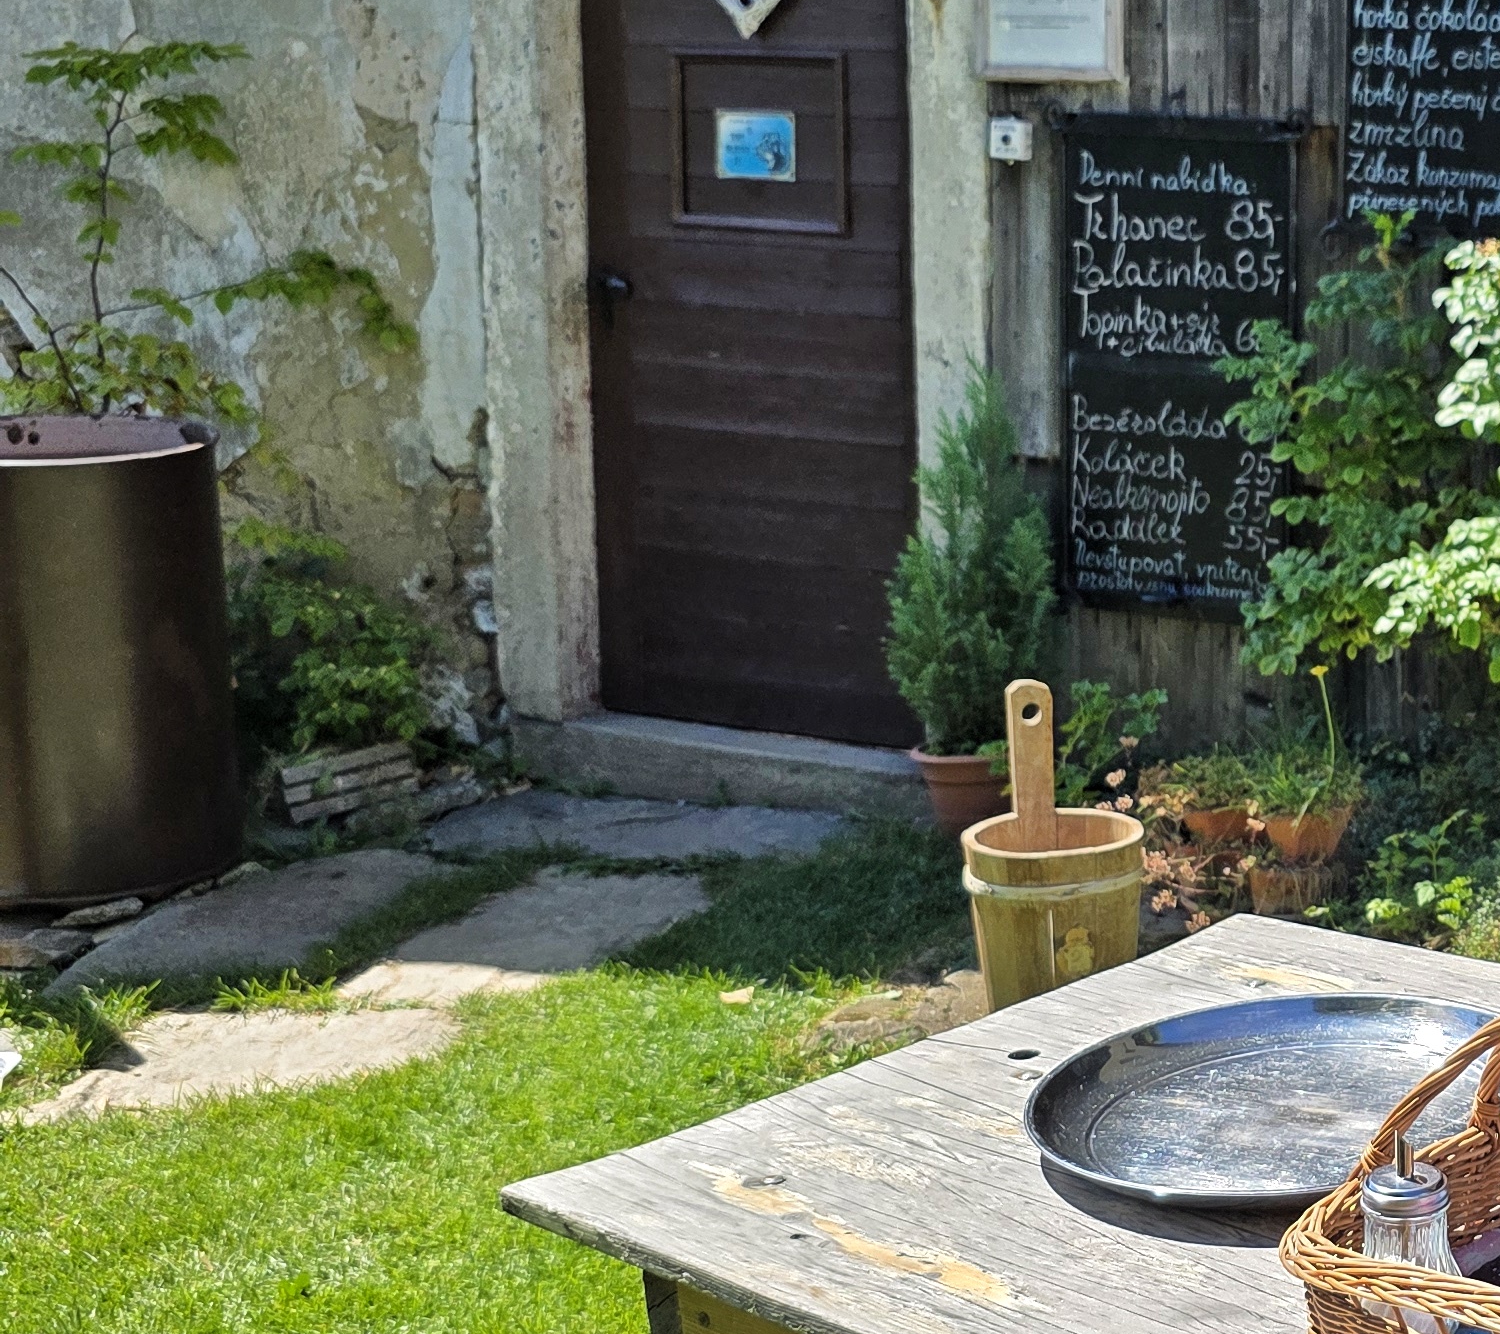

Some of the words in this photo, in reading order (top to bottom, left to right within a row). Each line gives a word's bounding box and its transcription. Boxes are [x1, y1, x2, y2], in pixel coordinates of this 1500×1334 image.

[1352, 70, 1408, 118] horký
[1411, 85, 1488, 121] pečený
[1348, 108, 1465, 151] zmrzlina
[1079, 149, 1144, 188] Denní
[1347, 149, 1410, 186] Zákaz
[1073, 191, 1207, 242] Trhanec
[1347, 187, 1469, 222] přinesených
[1072, 239, 1236, 290] Palačinka
[1072, 286, 1167, 350] Topinka
